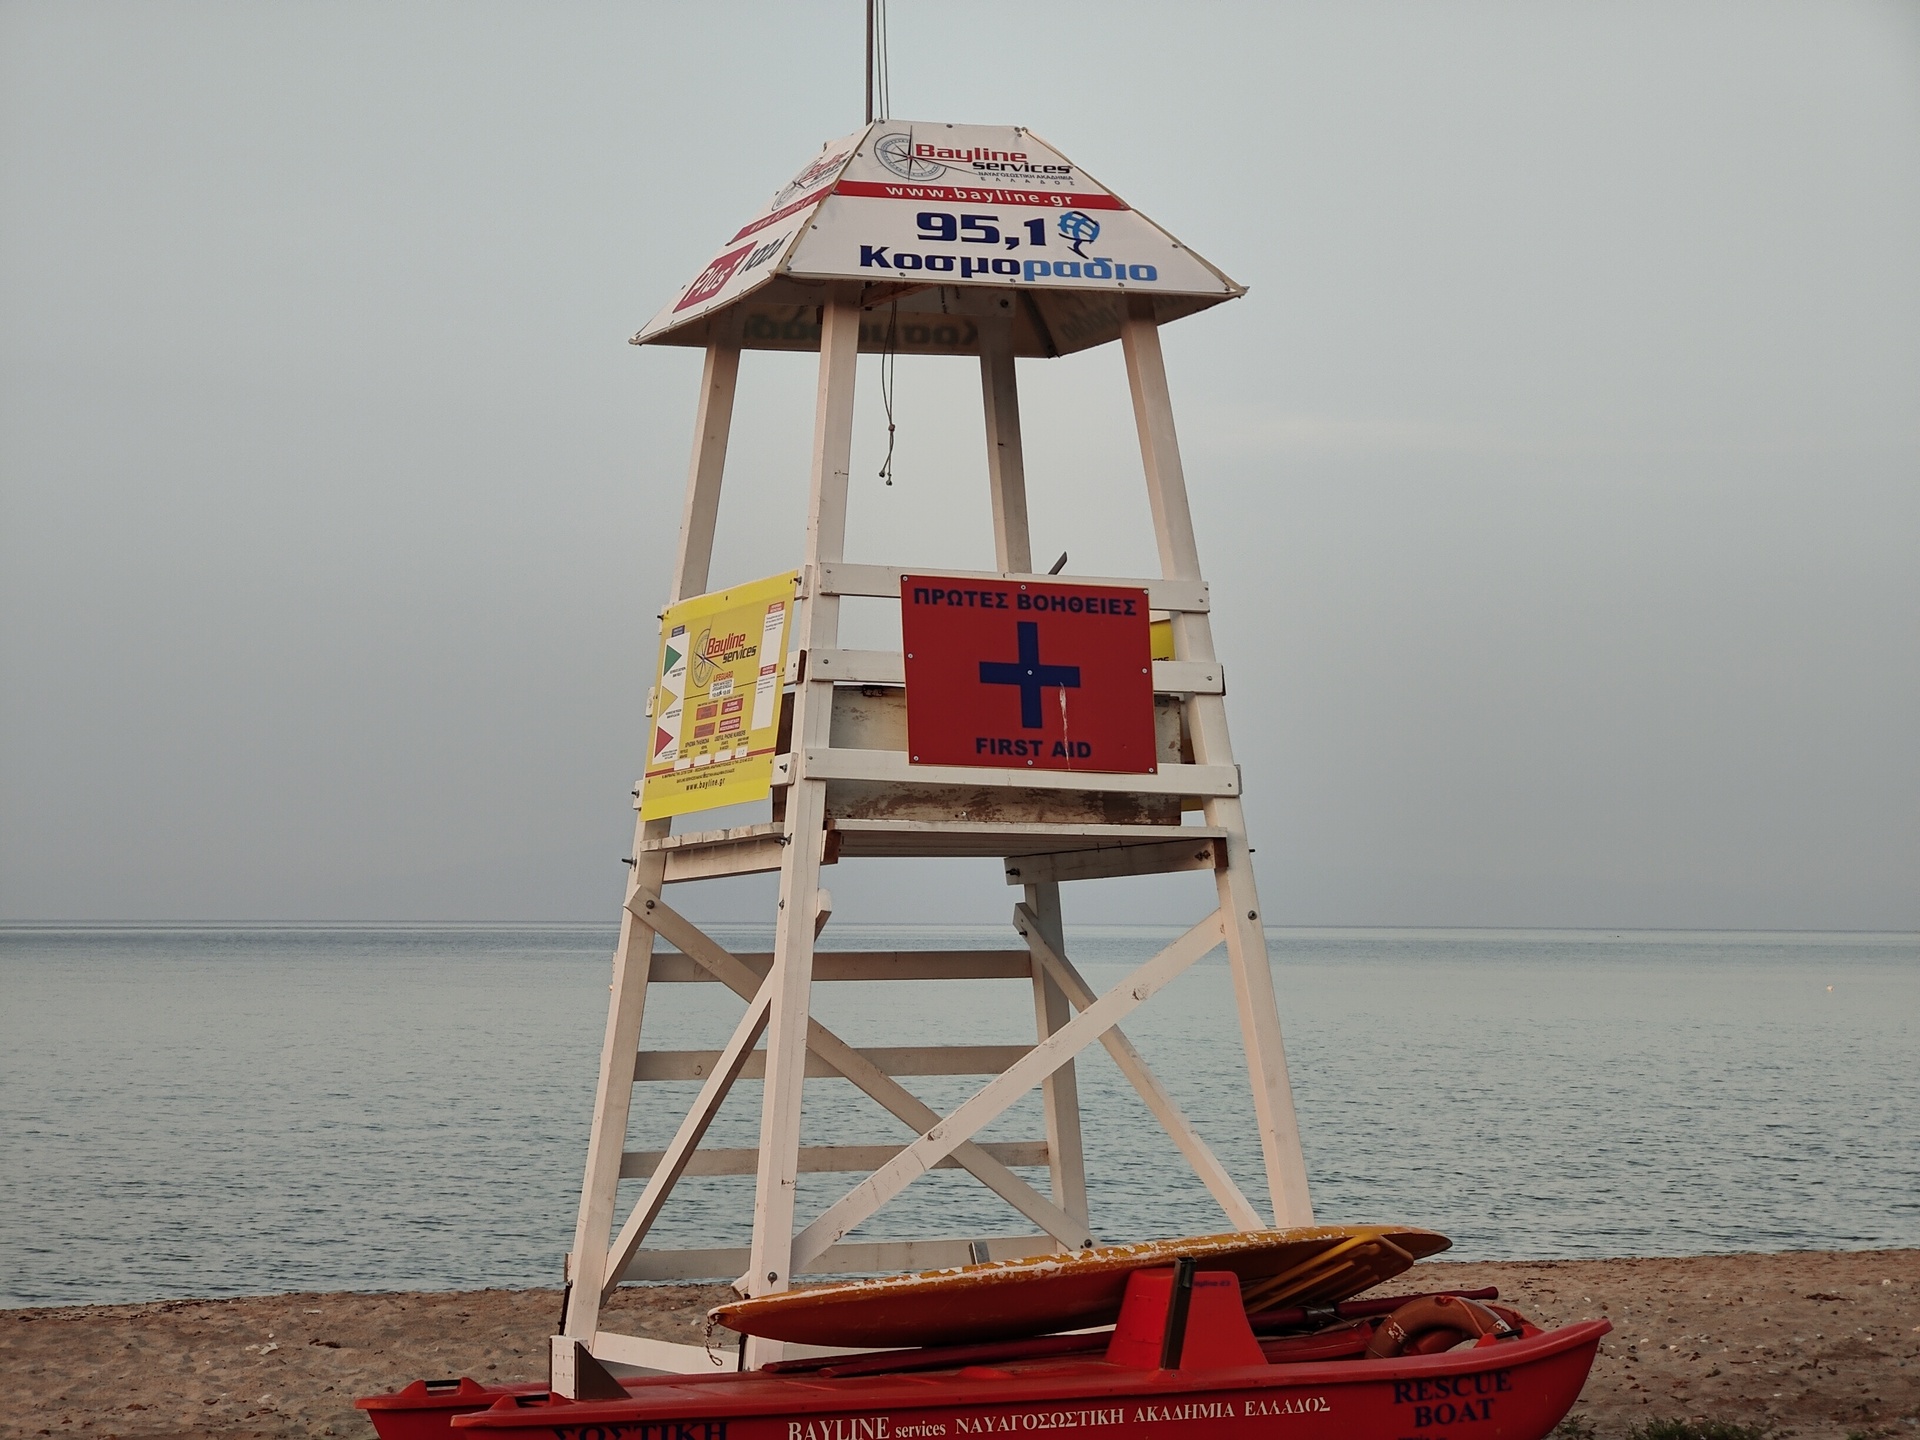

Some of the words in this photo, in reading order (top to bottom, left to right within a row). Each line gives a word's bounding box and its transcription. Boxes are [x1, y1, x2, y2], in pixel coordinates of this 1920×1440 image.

[915, 143, 1027, 163] Bayline
[972, 161, 1071, 174] services
[885, 186, 1072, 207] www.bayline.gr
[916, 211, 1047, 250] 95,1
[859, 244, 1158, 282] Κοσμοραδιο
[913, 587, 1009, 610] ΠΡΩΤΕΣ
[1016, 593, 1137, 617] ΒΟΗΘΕΙΕΣ
[706, 632, 747, 658] Bayline
[722, 644, 757, 664] services
[975, 737, 1043, 757] FIRST
[1051, 741, 1092, 759] AID
[1393, 1370, 1512, 1404] RESCUE
[787, 1416, 890, 1440] BAYLINE
[895, 1420, 946, 1438] services
[955, 1408, 1124, 1435] ΝΑΥΑΓΟΣΩΣΤΙΚΗ
[1133, 1402, 1235, 1423] ΑΚΑΔΗΜΙΑ
[1244, 1396, 1331, 1417] ΕΛΛΑΔΟΣ
[1414, 1398, 1495, 1428] BOAT
